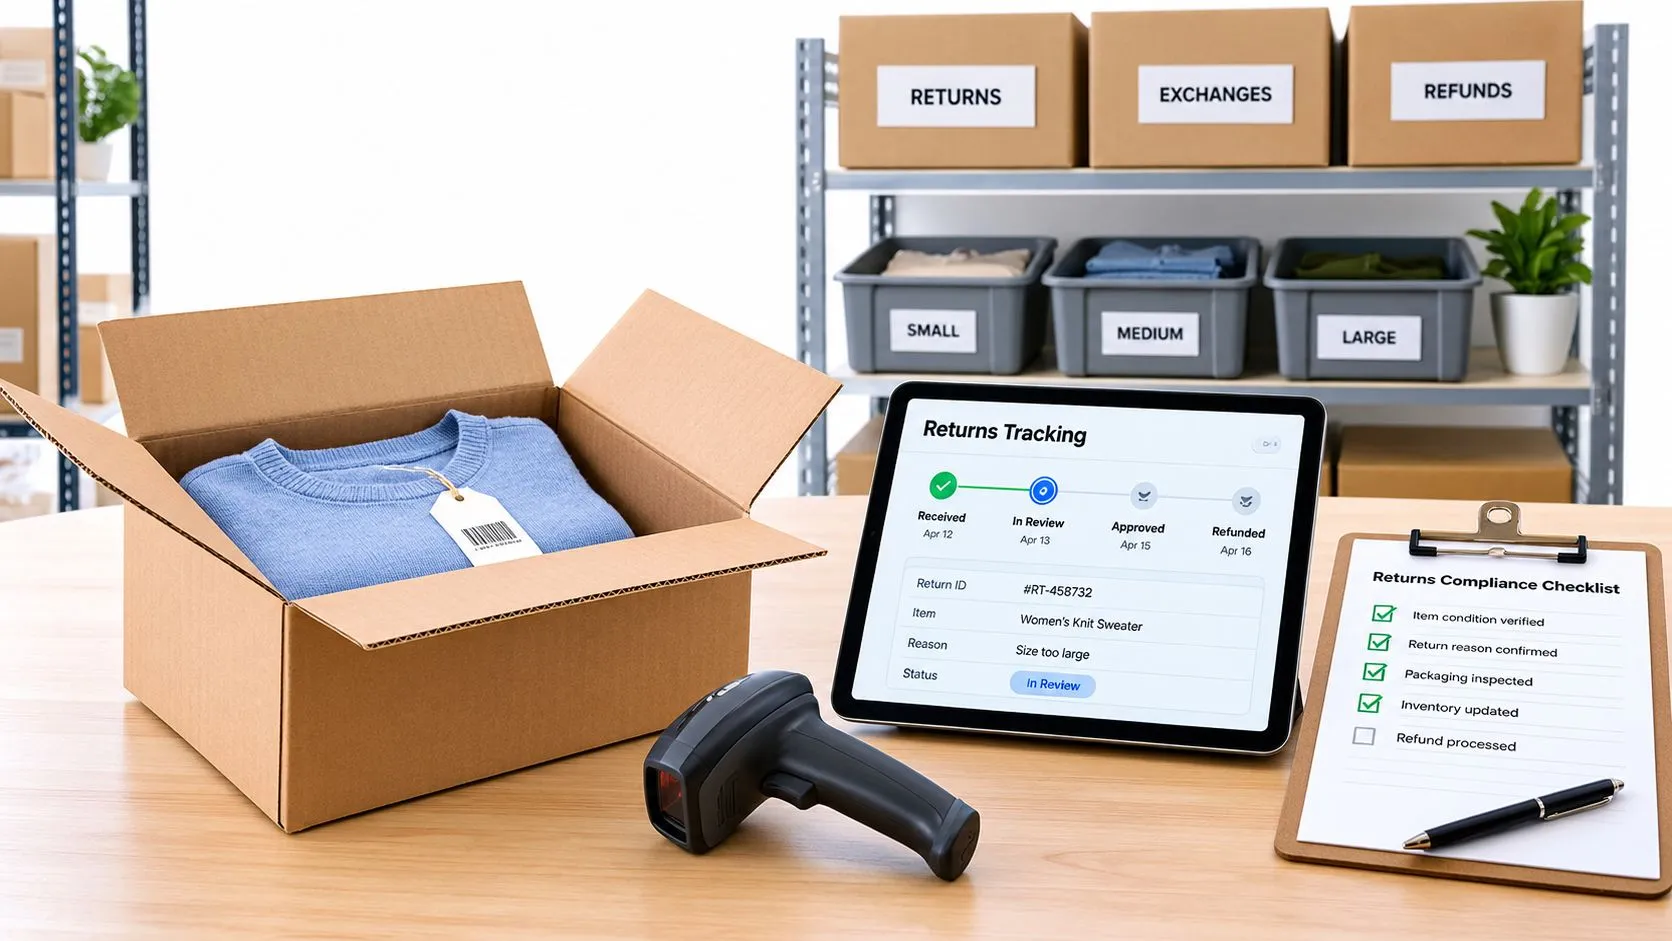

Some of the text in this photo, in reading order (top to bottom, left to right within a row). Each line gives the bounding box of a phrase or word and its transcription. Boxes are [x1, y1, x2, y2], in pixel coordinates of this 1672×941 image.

[911, 88, 1002, 106] RETURNS
[1159, 85, 1273, 103] EXCHANGES
[1424, 82, 1513, 100] REFUNDS
[907, 322, 960, 338] SMALL
[1117, 326, 1184, 341] MEDIUM
[1342, 330, 1397, 345] LARGE
[922, 419, 1088, 448] Returns Tracking
[917, 510, 967, 523] Received
[1012, 516, 1065, 529] In Review
[922, 528, 954, 540] Apr 12
[1111, 521, 1166, 535] Approved
[1211, 526, 1266, 539] Refunded
[1019, 535, 1051, 546] Apr 13
[1119, 539, 1152, 552] Apr 15
[1219, 545, 1252, 557] Apr 16
[916, 577, 968, 591] Return ID
[1372, 571, 1621, 595] Returns Compliance Checklist
[1023, 584, 1093, 598] #RT-458732
[912, 607, 937, 619] Item
[1412, 610, 1545, 627] Item condition verified
[1020, 613, 1144, 632] Women's Knit Sweater
[907, 637, 948, 651] Reason
[1408, 639, 1558, 658] Return reason confirmed
[1015, 644, 1090, 662] Size too large
[902, 667, 938, 681] Status
[1404, 669, 1533, 687] Packaging inspected
[1026, 678, 1081, 691] In Review
[1401, 699, 1519, 718] Inventory updated
[1396, 732, 1517, 752] Refund processed
